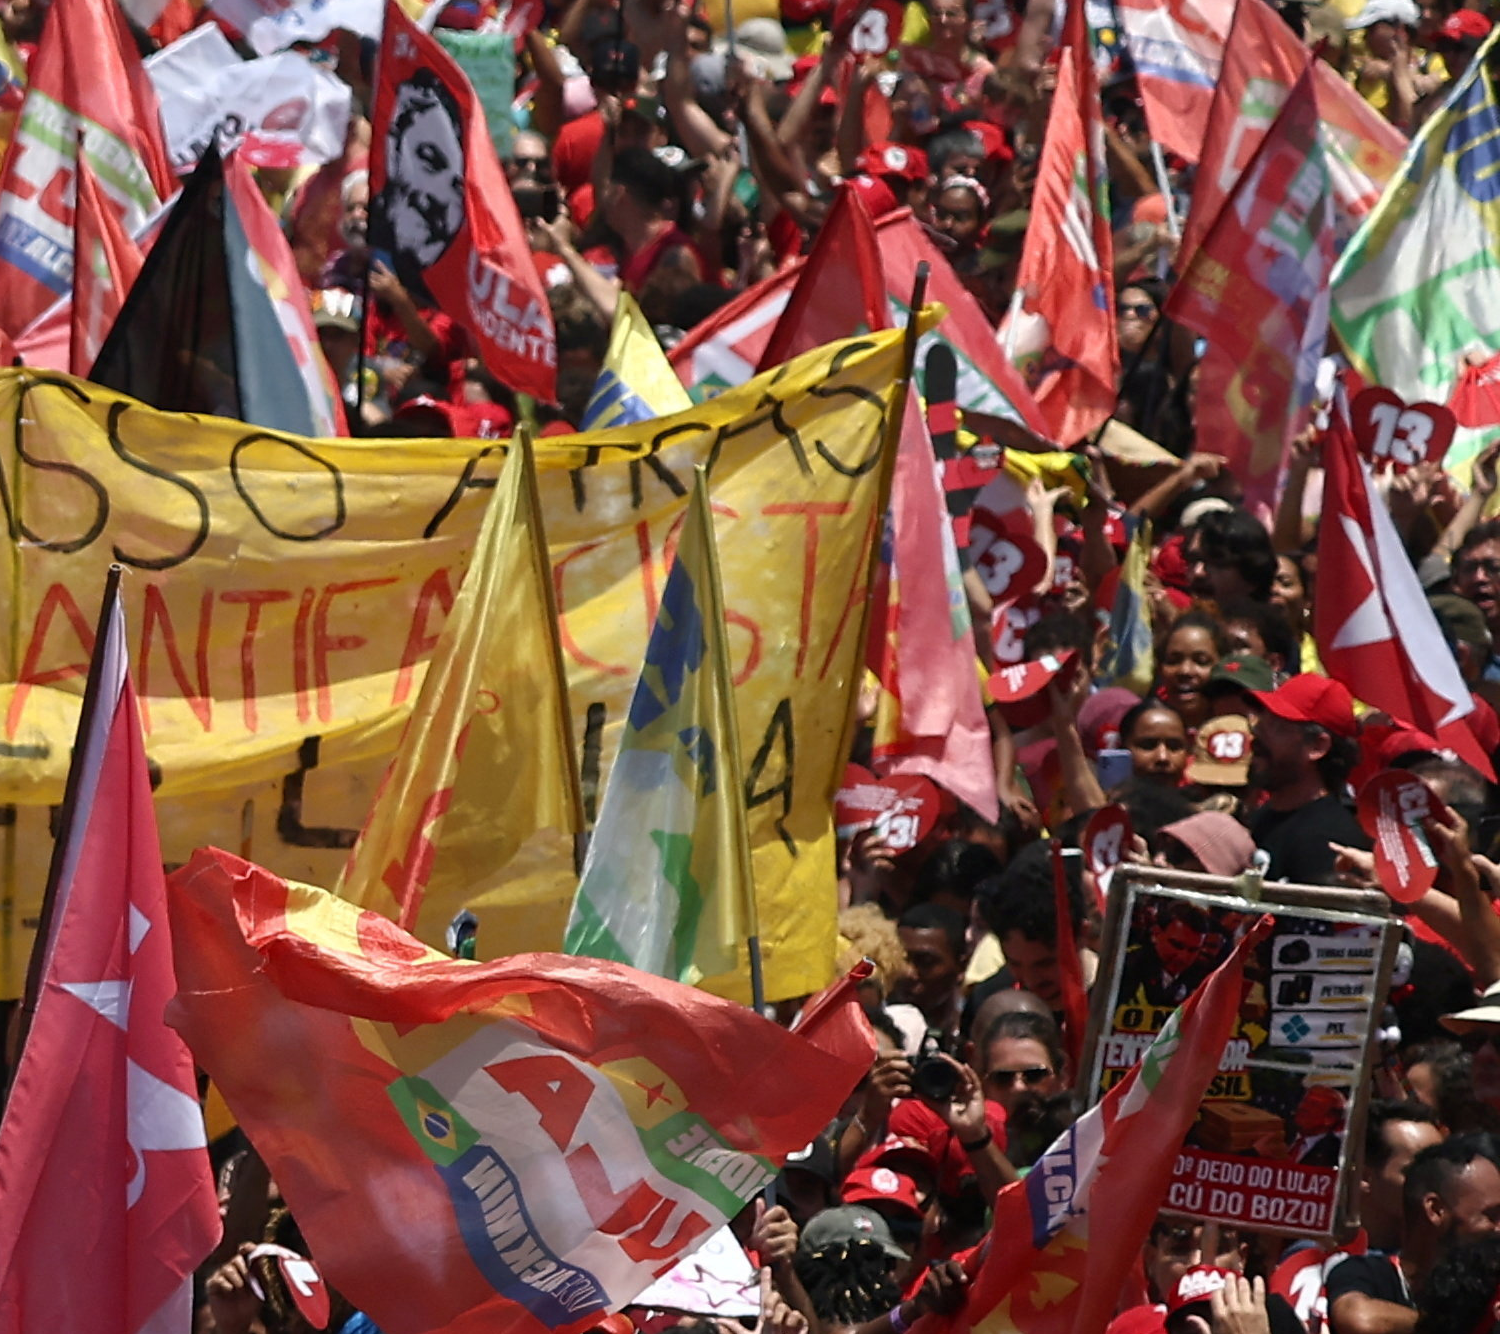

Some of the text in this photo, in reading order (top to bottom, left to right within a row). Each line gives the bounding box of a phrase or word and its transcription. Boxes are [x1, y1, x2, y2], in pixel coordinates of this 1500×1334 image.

[467, 247, 554, 331] ULA
[1372, 401, 1433, 465] 13
[1210, 731, 1245, 758] 13
[1196, 1159, 1332, 1196] DEDO DO LULA?
[1210, 1185, 1245, 1215] DO
[1250, 1192, 1329, 1228] BOZO!
